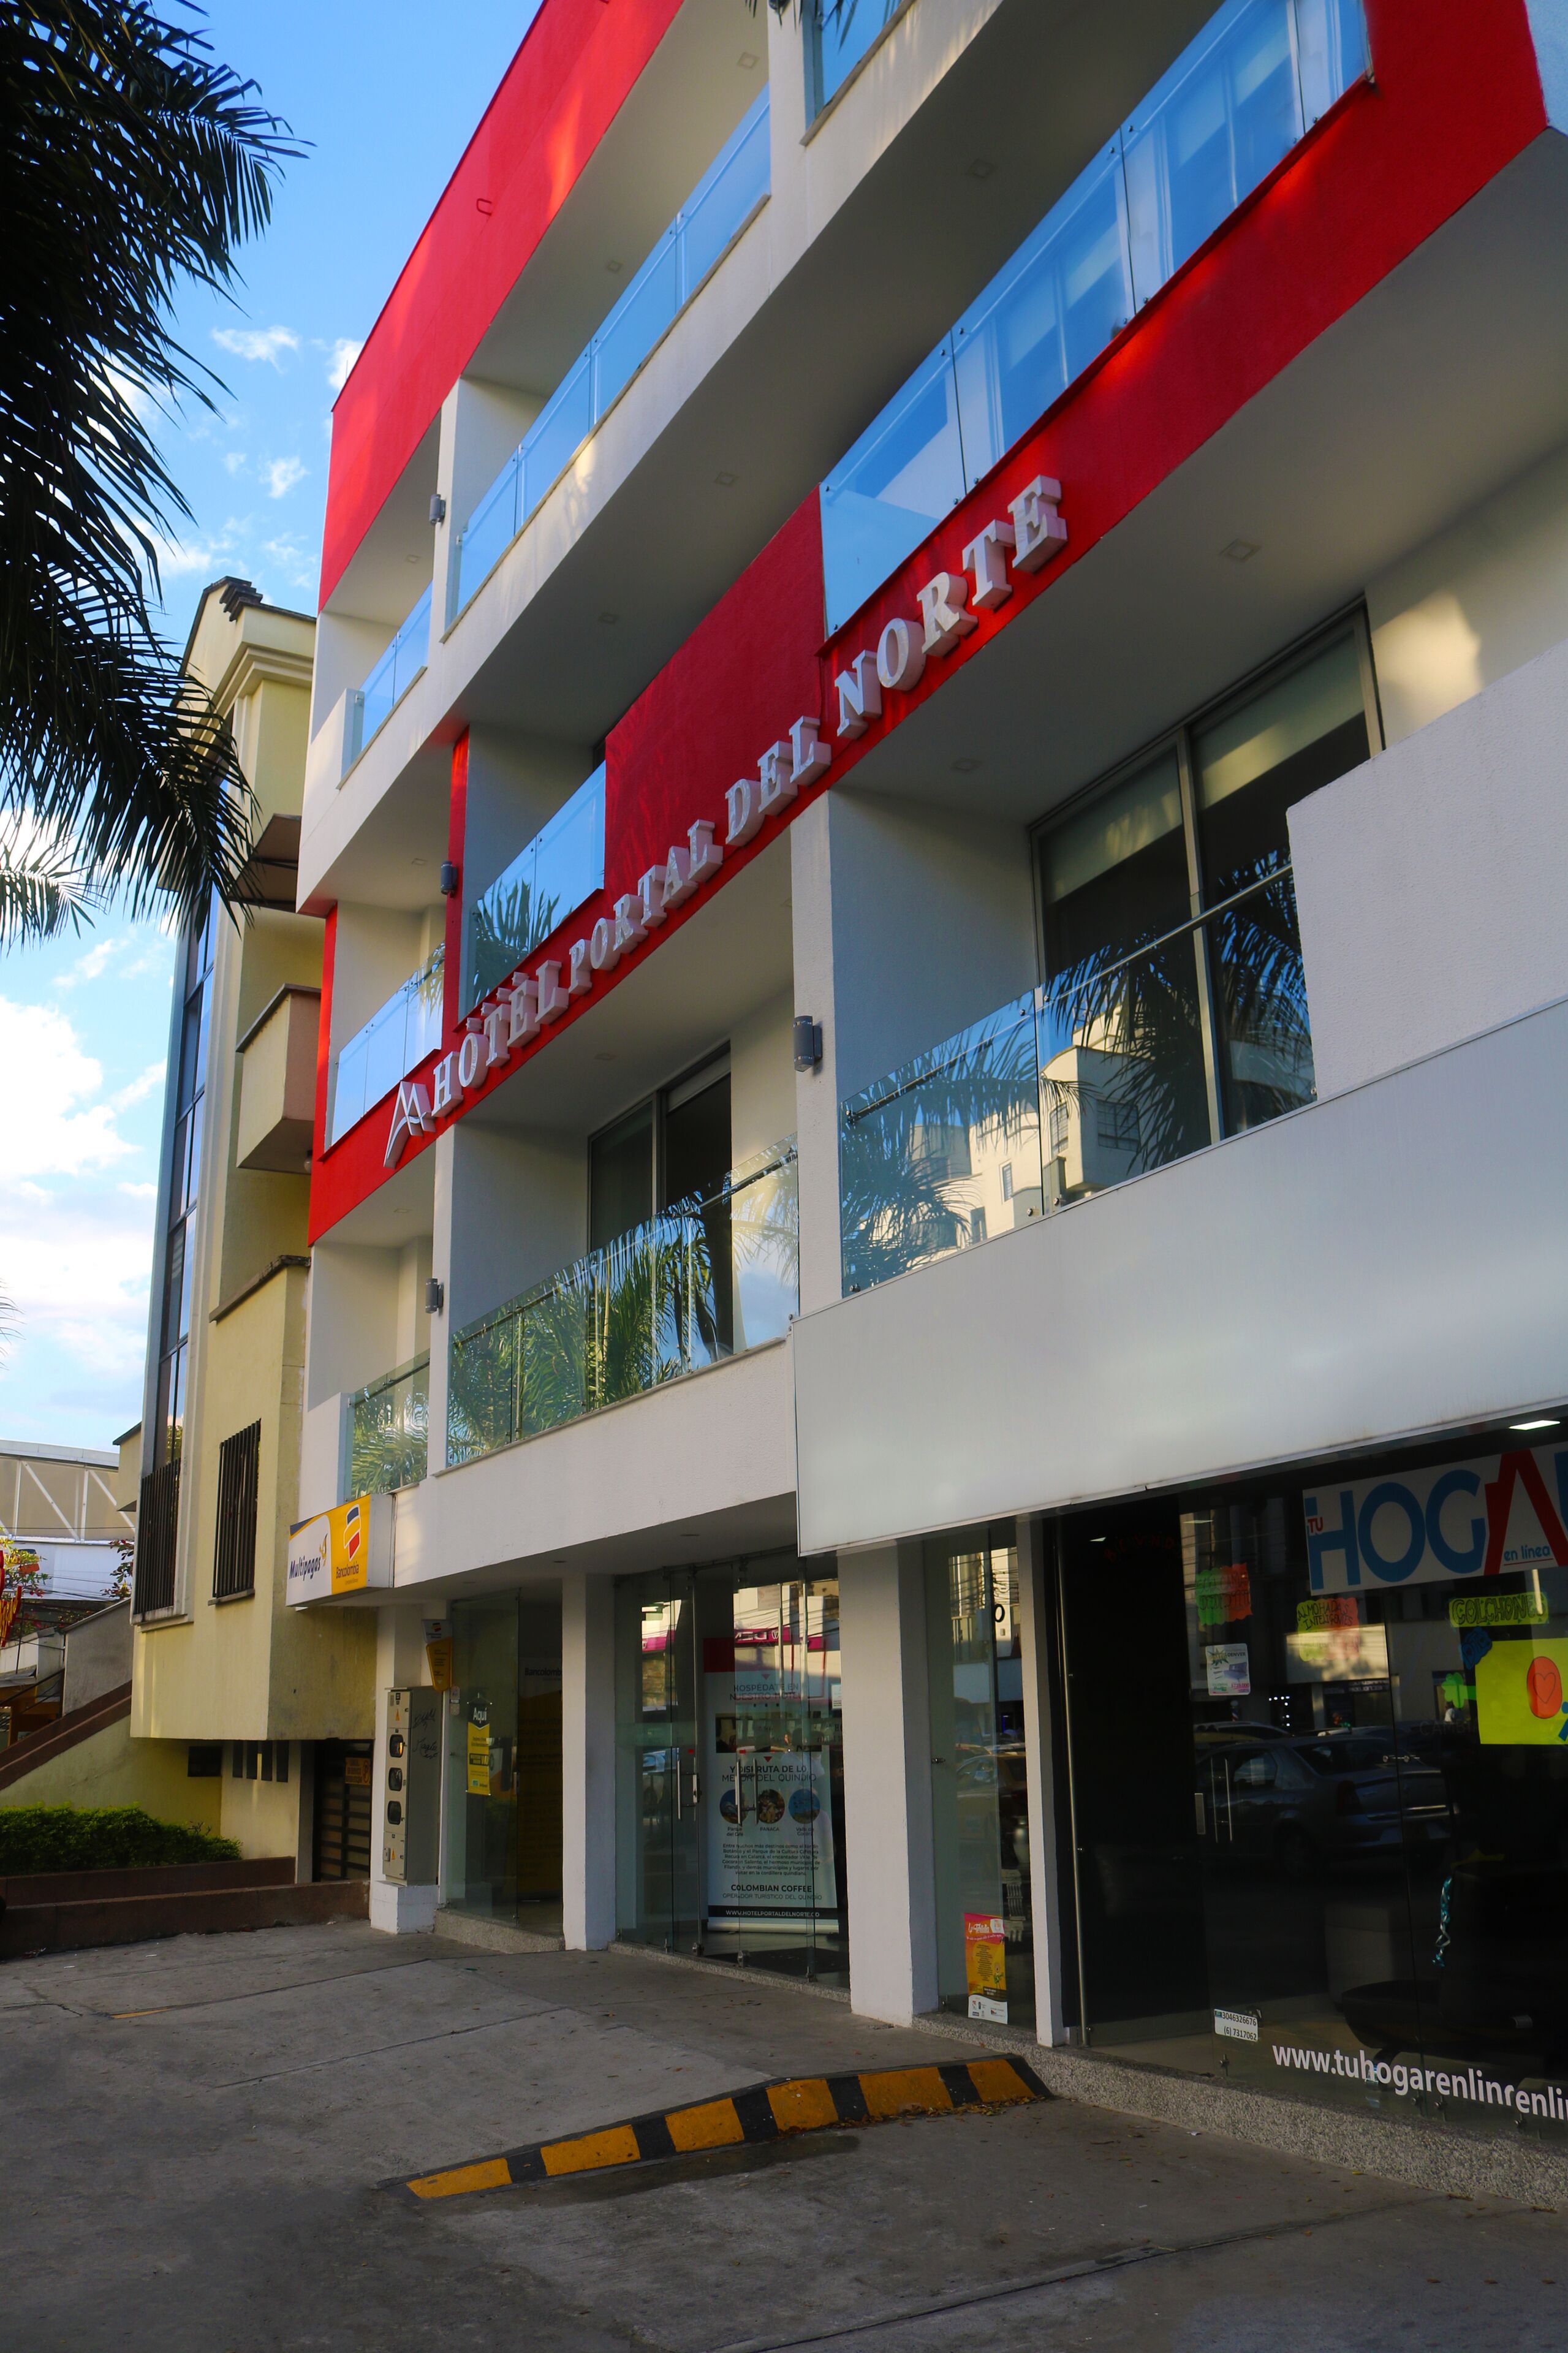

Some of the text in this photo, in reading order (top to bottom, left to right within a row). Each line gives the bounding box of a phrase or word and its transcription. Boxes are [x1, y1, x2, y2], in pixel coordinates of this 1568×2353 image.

[431, 474, 1067, 1117] HOTEL PORTAL DEL NORTE
[1308, 1517, 1324, 1533] TU
[1504, 1544, 1550, 1561] en línea
[289, 1555, 321, 1581] Multipagas
[336, 1561, 359, 1578] Bancolombia
[473, 1707, 487, 1724] Aquí
[1222, 2012, 1256, 2026] 3046326676
[1233, 2029, 1257, 2040] 7317062
[1272, 2045, 1568, 2120] www.tuhogarenlinrenli
